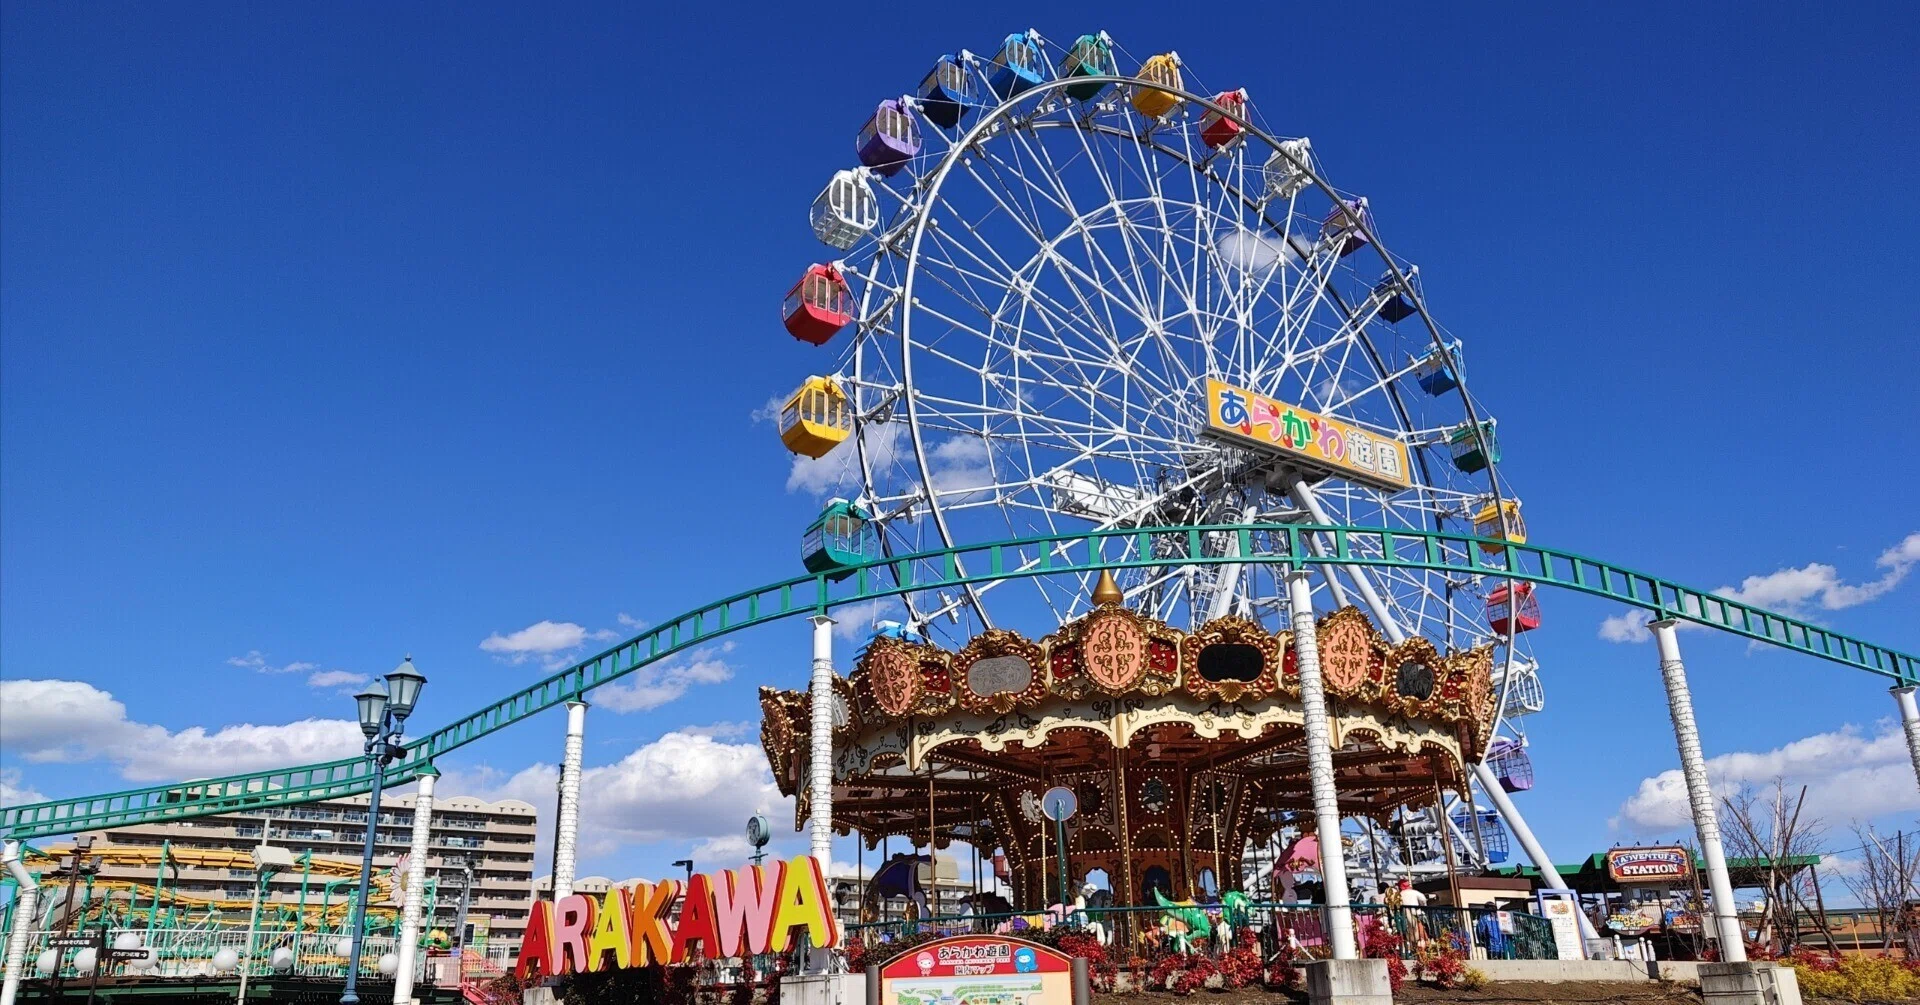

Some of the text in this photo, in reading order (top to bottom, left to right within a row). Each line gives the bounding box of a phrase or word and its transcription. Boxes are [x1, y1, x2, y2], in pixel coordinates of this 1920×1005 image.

[1218, 389, 1404, 481] あらかわ遊園
[1623, 864, 1678, 875] STATION
[515, 855, 838, 980] ARAKAWA
[938, 944, 1011, 959] あらかわ遊園
[955, 964, 995, 976] 園内マップ
